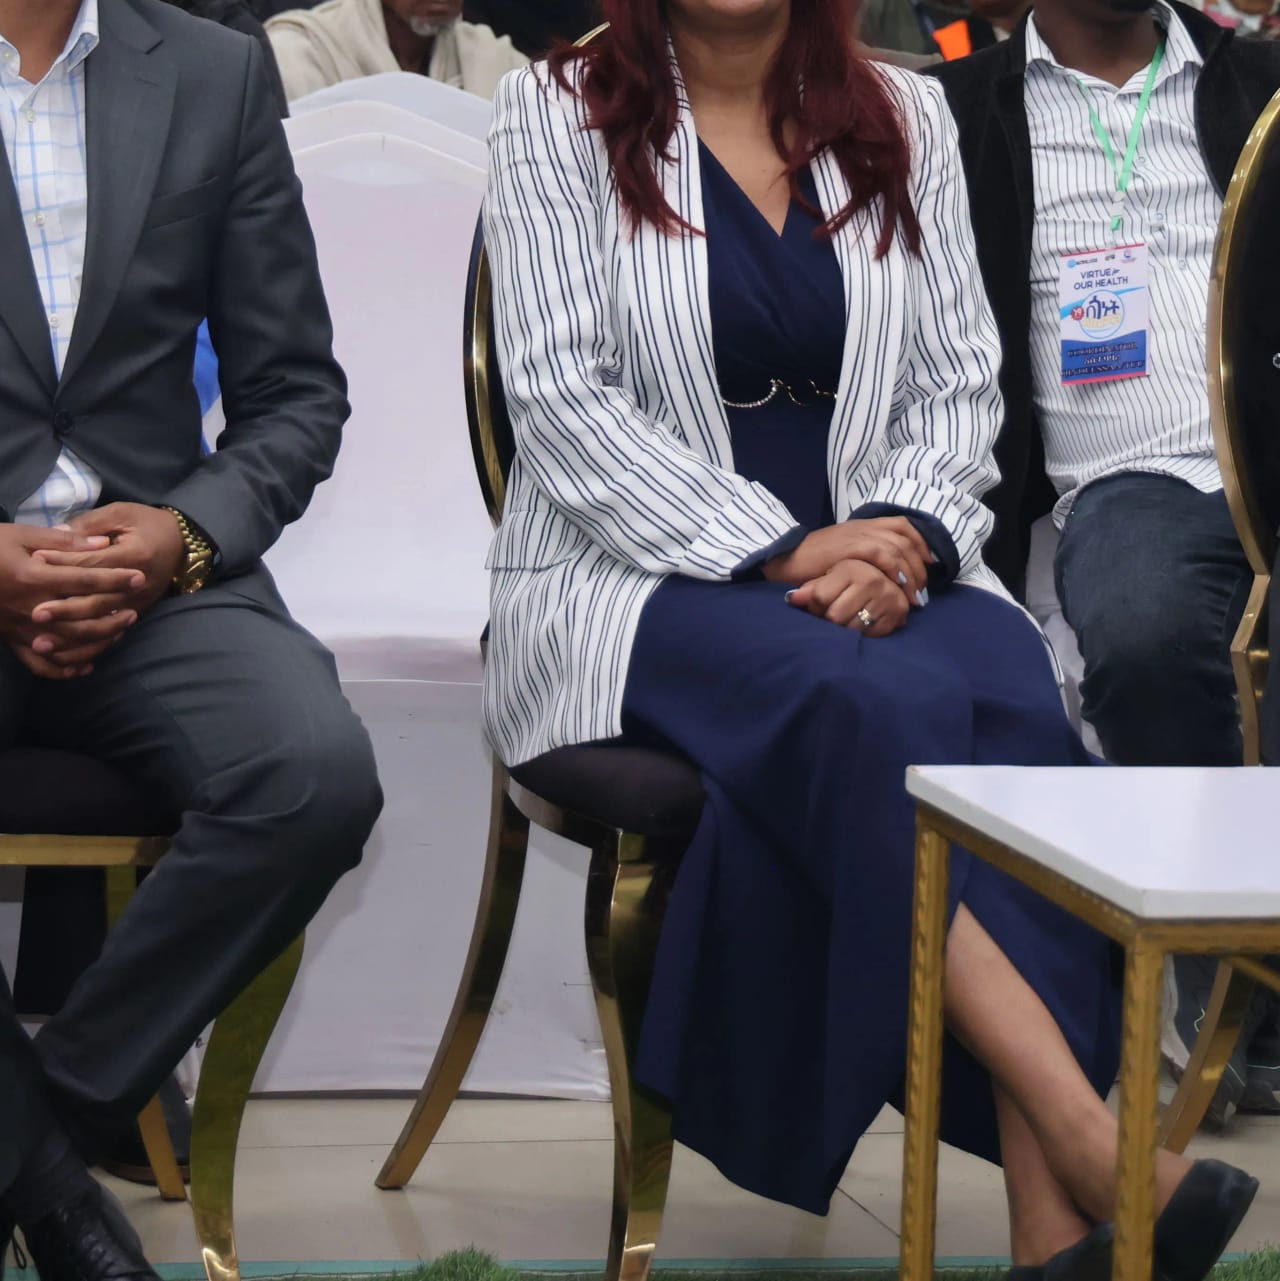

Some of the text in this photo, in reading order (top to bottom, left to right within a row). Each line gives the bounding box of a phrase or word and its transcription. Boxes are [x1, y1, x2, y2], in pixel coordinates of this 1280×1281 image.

[1080, 268, 1111, 279] VIRTUE
[1073, 276, 1128, 290] OUR HEALTH
